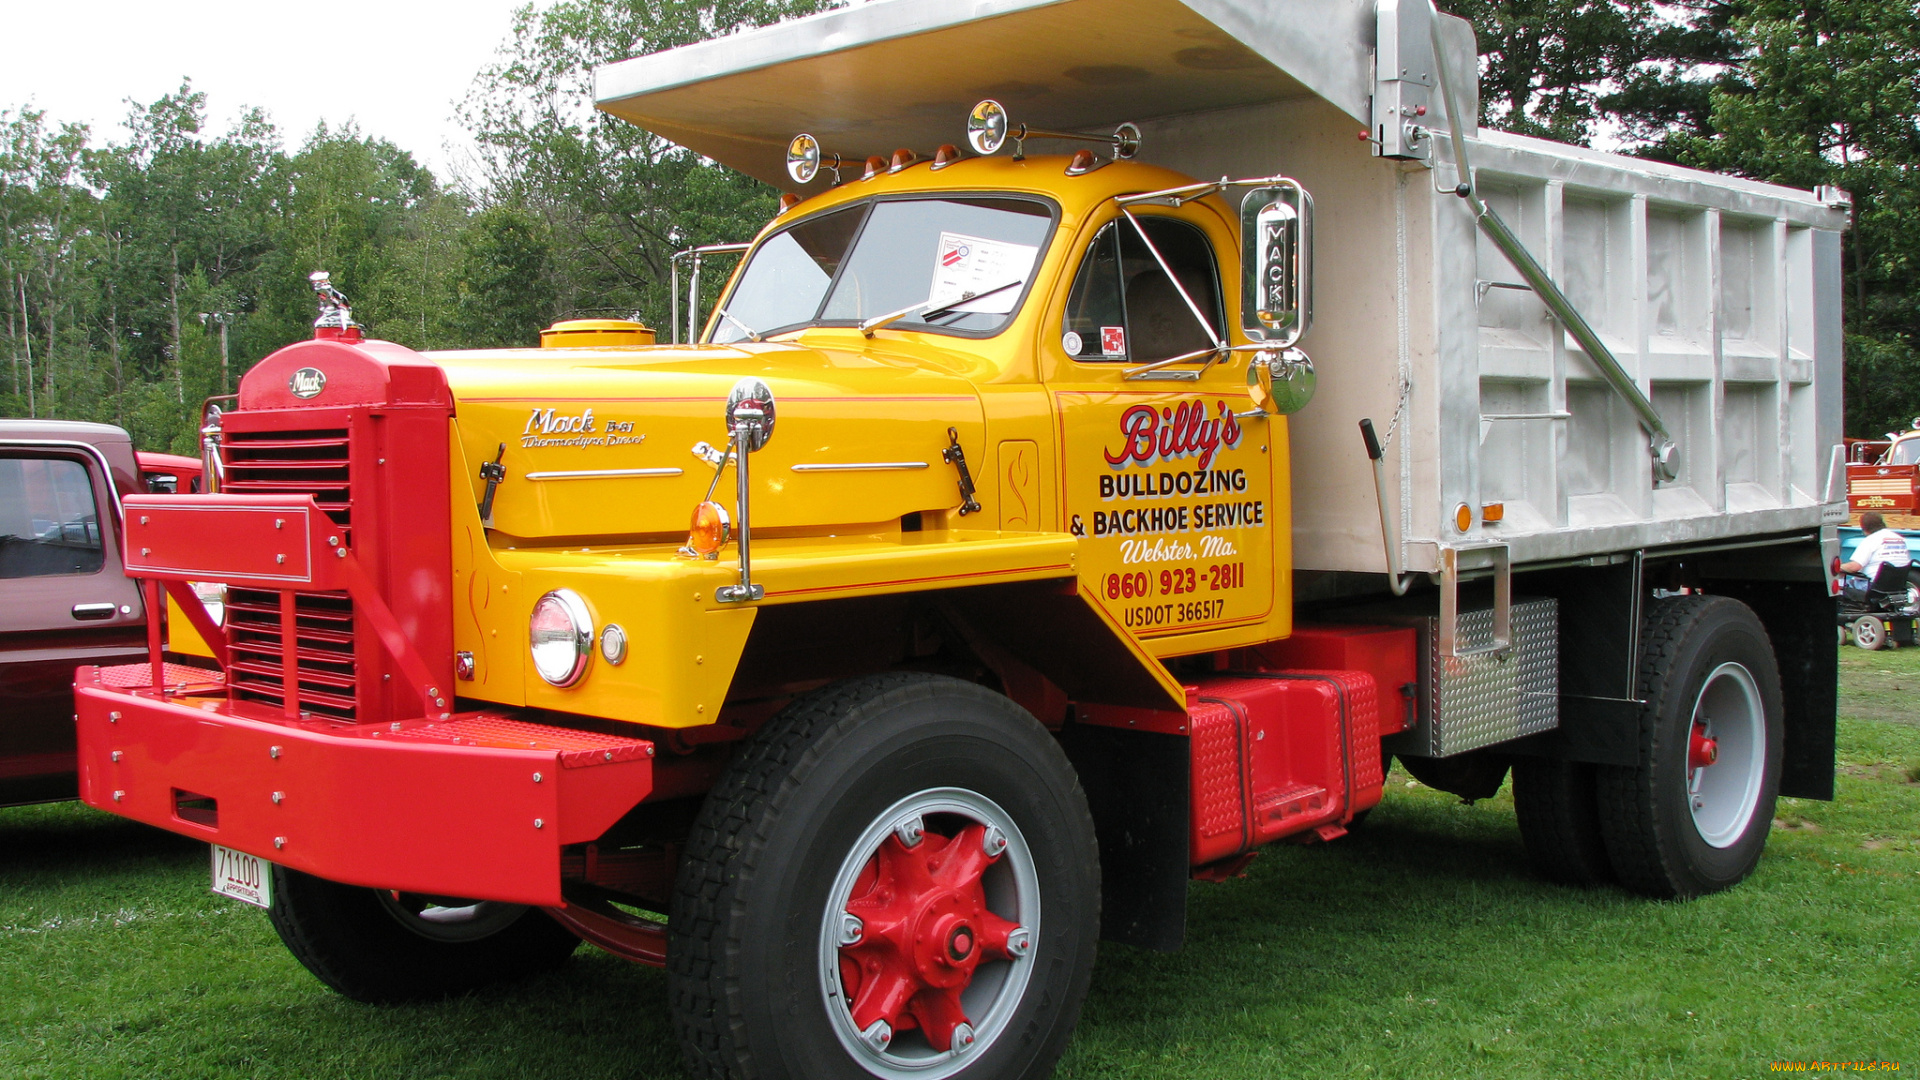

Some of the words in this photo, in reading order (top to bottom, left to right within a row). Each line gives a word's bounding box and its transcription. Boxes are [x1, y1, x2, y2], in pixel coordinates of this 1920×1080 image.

[1265, 226, 1286, 303] MACK
[292, 371, 321, 392] Mack
[522, 408, 597, 434] Mack
[1104, 399, 1242, 470] Billy's
[521, 435, 604, 449] Thermodyne
[605, 434, 646, 447] Diesel
[1100, 468, 1247, 499] BULLDOZING
[1070, 514, 1087, 537] &
[1093, 506, 1189, 536] BACKHOE
[1193, 501, 1264, 531] SERVICE
[1120, 538, 1198, 565] Webster,
[1200, 535, 1238, 558] Ma.
[1101, 569, 1154, 601] (860)
[1125, 604, 1173, 628] USDOT
[1178, 599, 1225, 622] 366517
[219, 847, 260, 889] 71100
